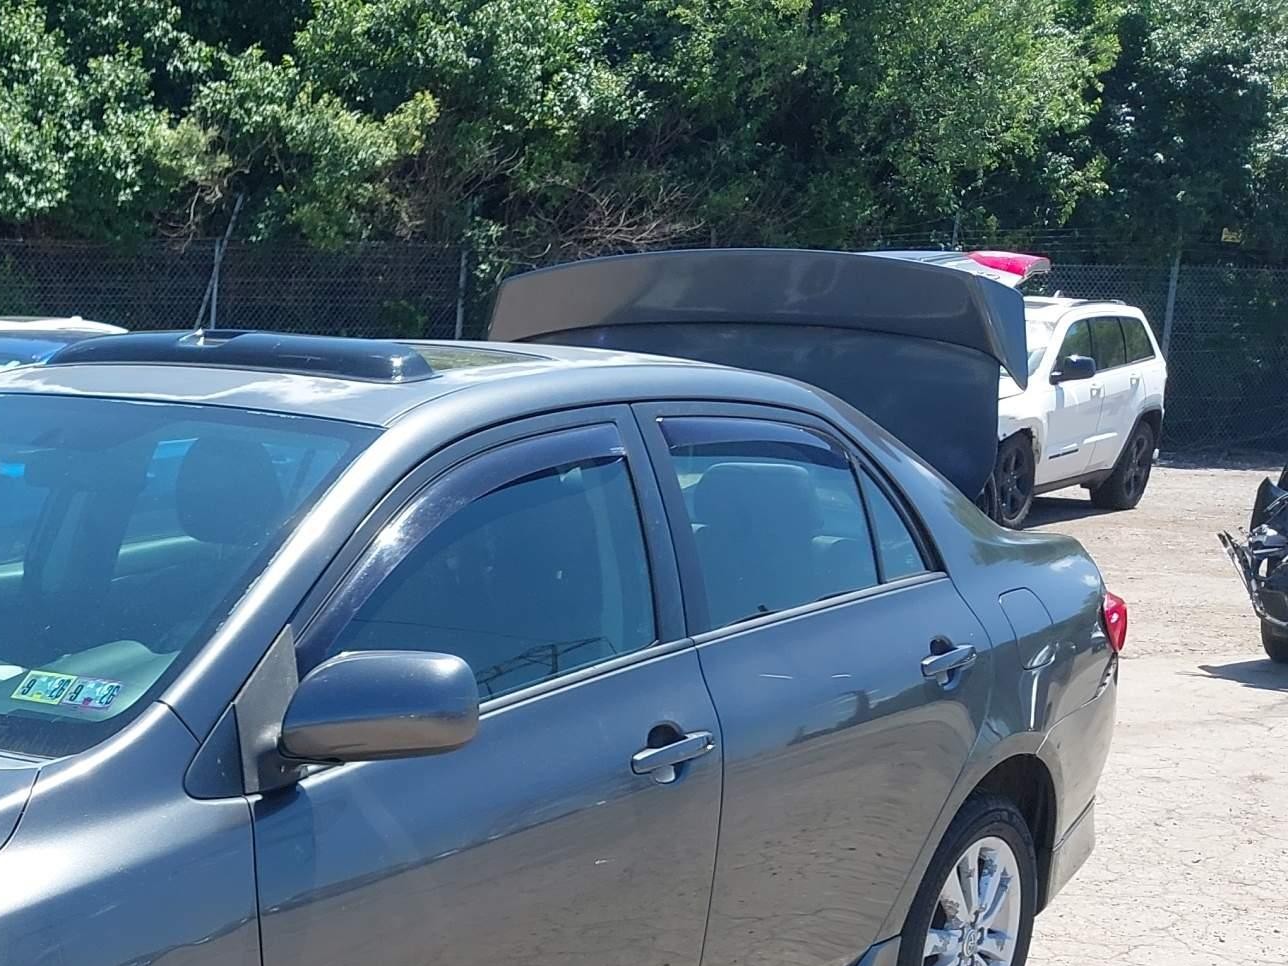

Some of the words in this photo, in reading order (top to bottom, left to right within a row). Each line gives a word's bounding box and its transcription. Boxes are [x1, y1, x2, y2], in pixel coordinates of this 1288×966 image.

[21, 678, 36, 696] 9
[48, 678, 73, 699] 26
[69, 684, 84, 702] 9
[99, 684, 121, 705] 26
